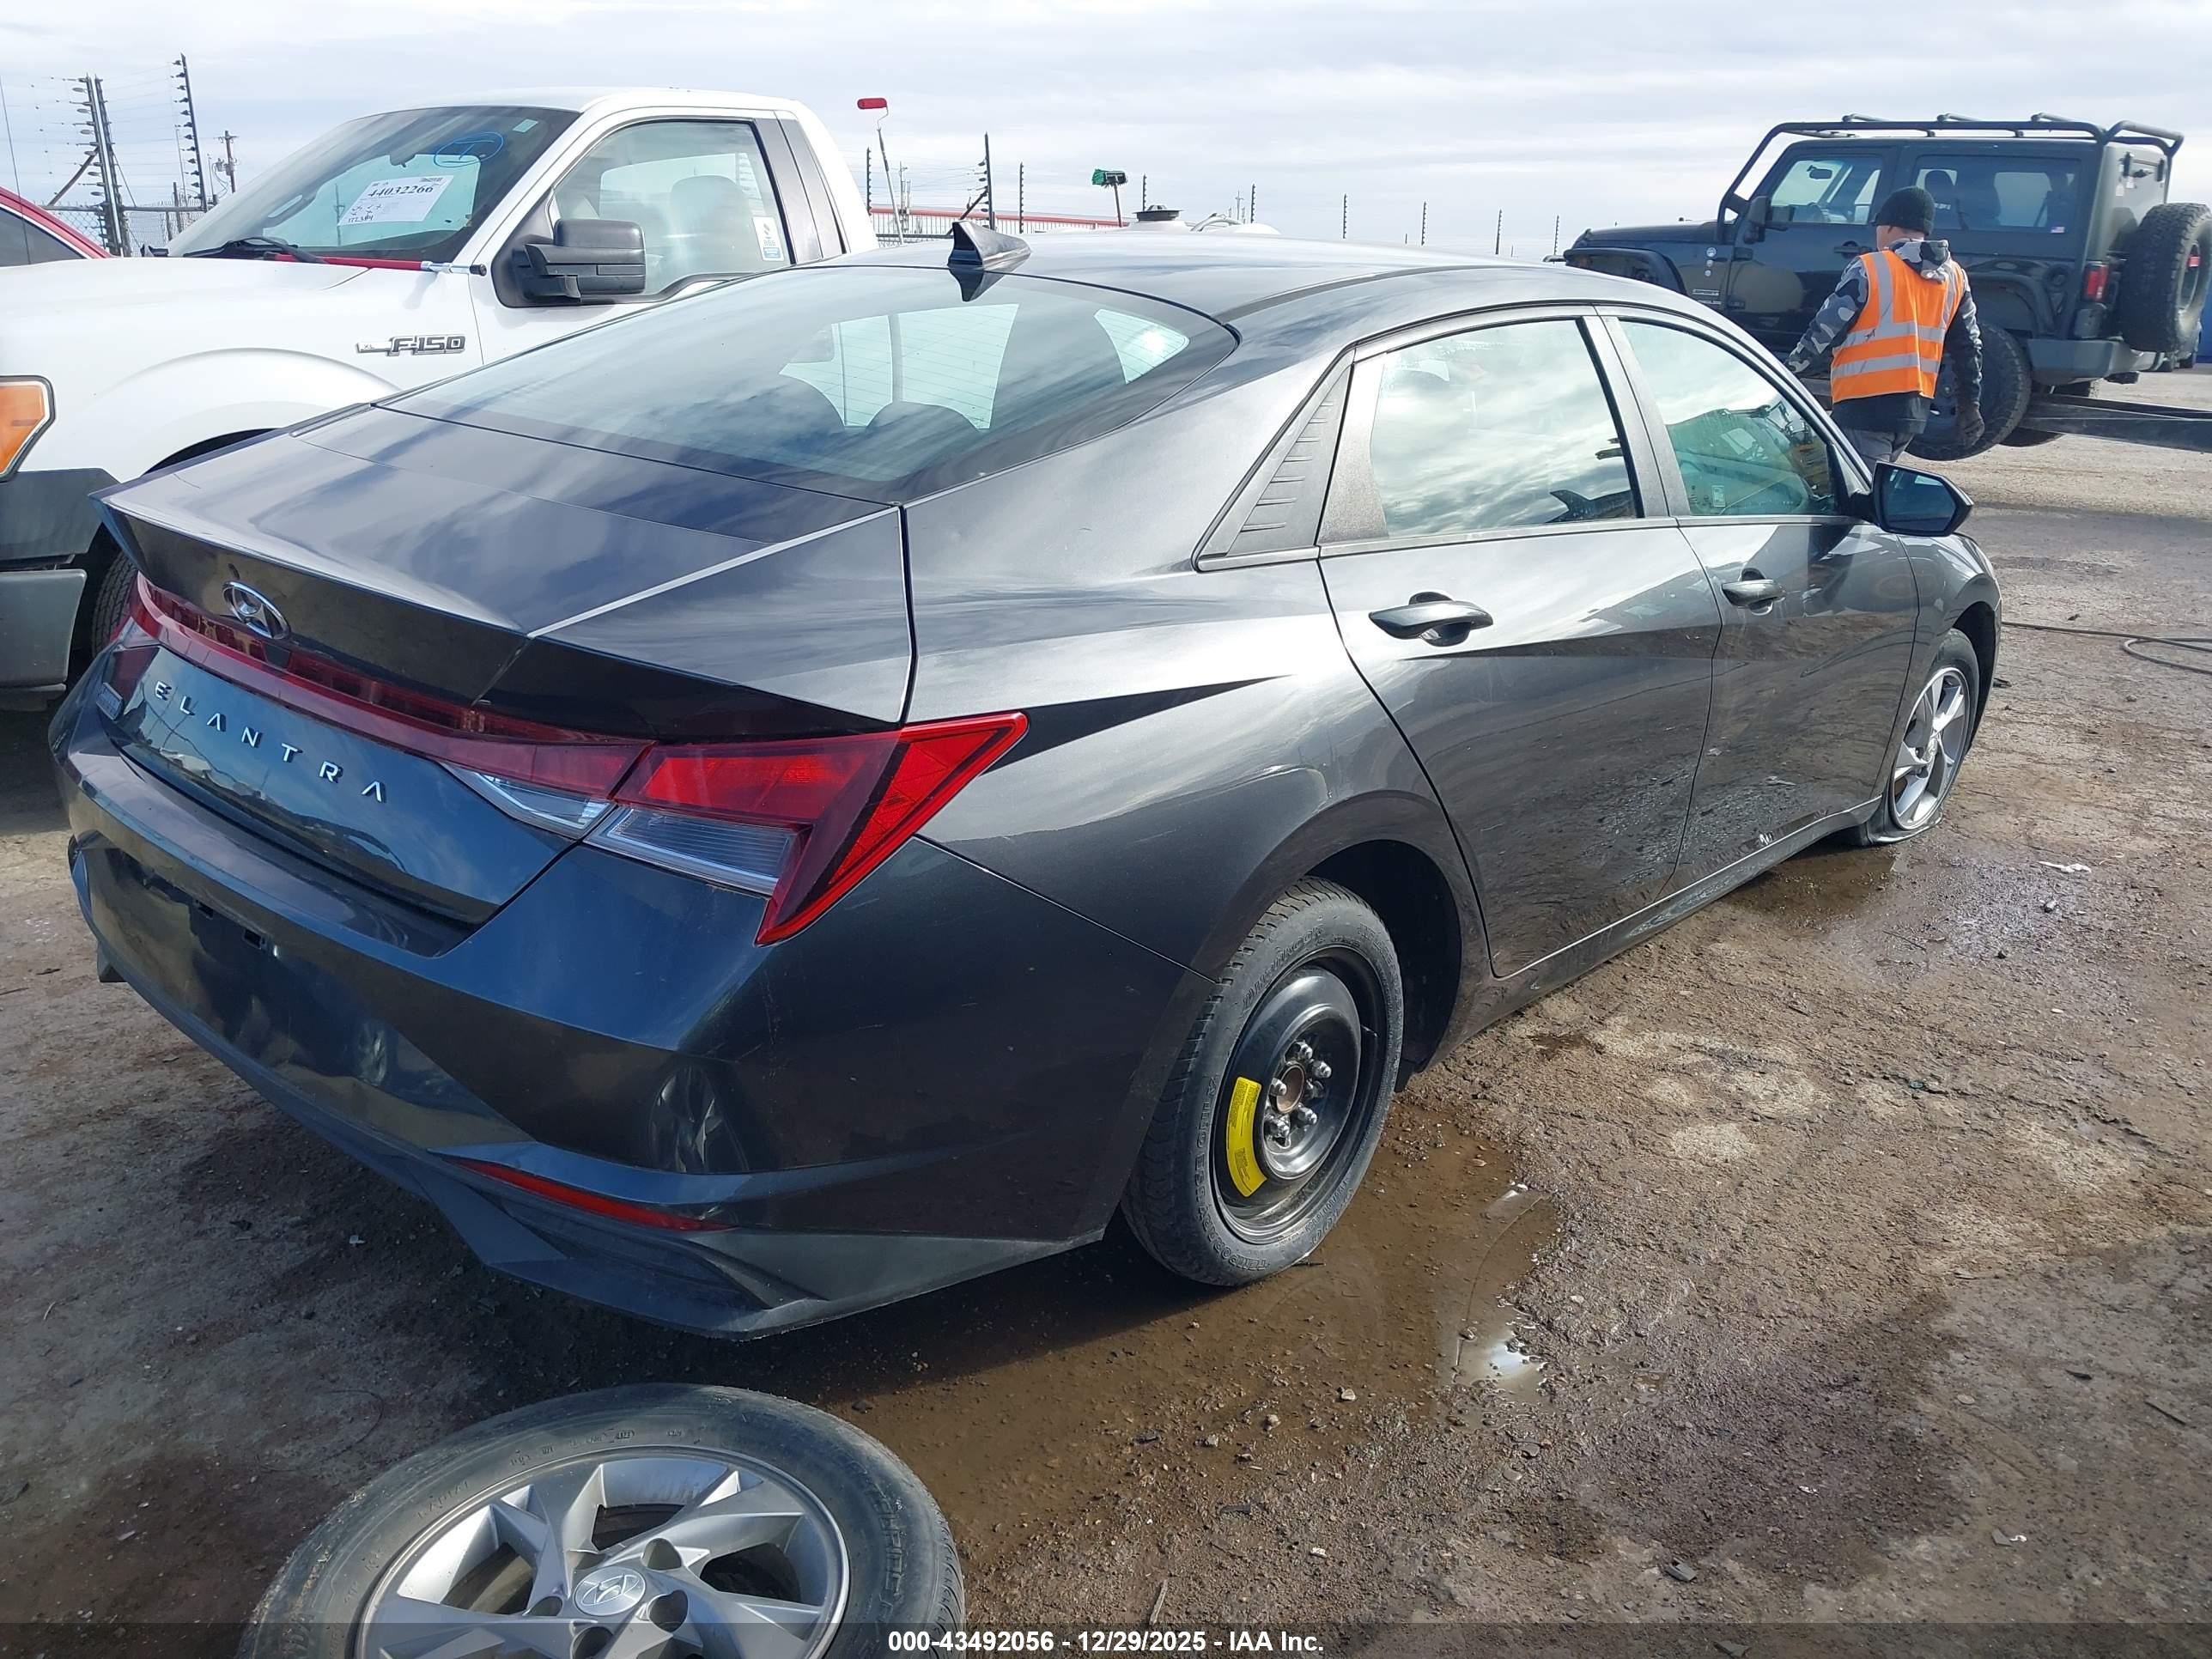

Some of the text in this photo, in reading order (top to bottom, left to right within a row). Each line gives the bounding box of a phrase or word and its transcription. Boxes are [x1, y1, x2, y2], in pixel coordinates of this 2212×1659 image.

[368, 185, 434, 197] 44032266
[391, 335, 465, 353] F-150
[155, 680, 386, 804] ELANTRA
